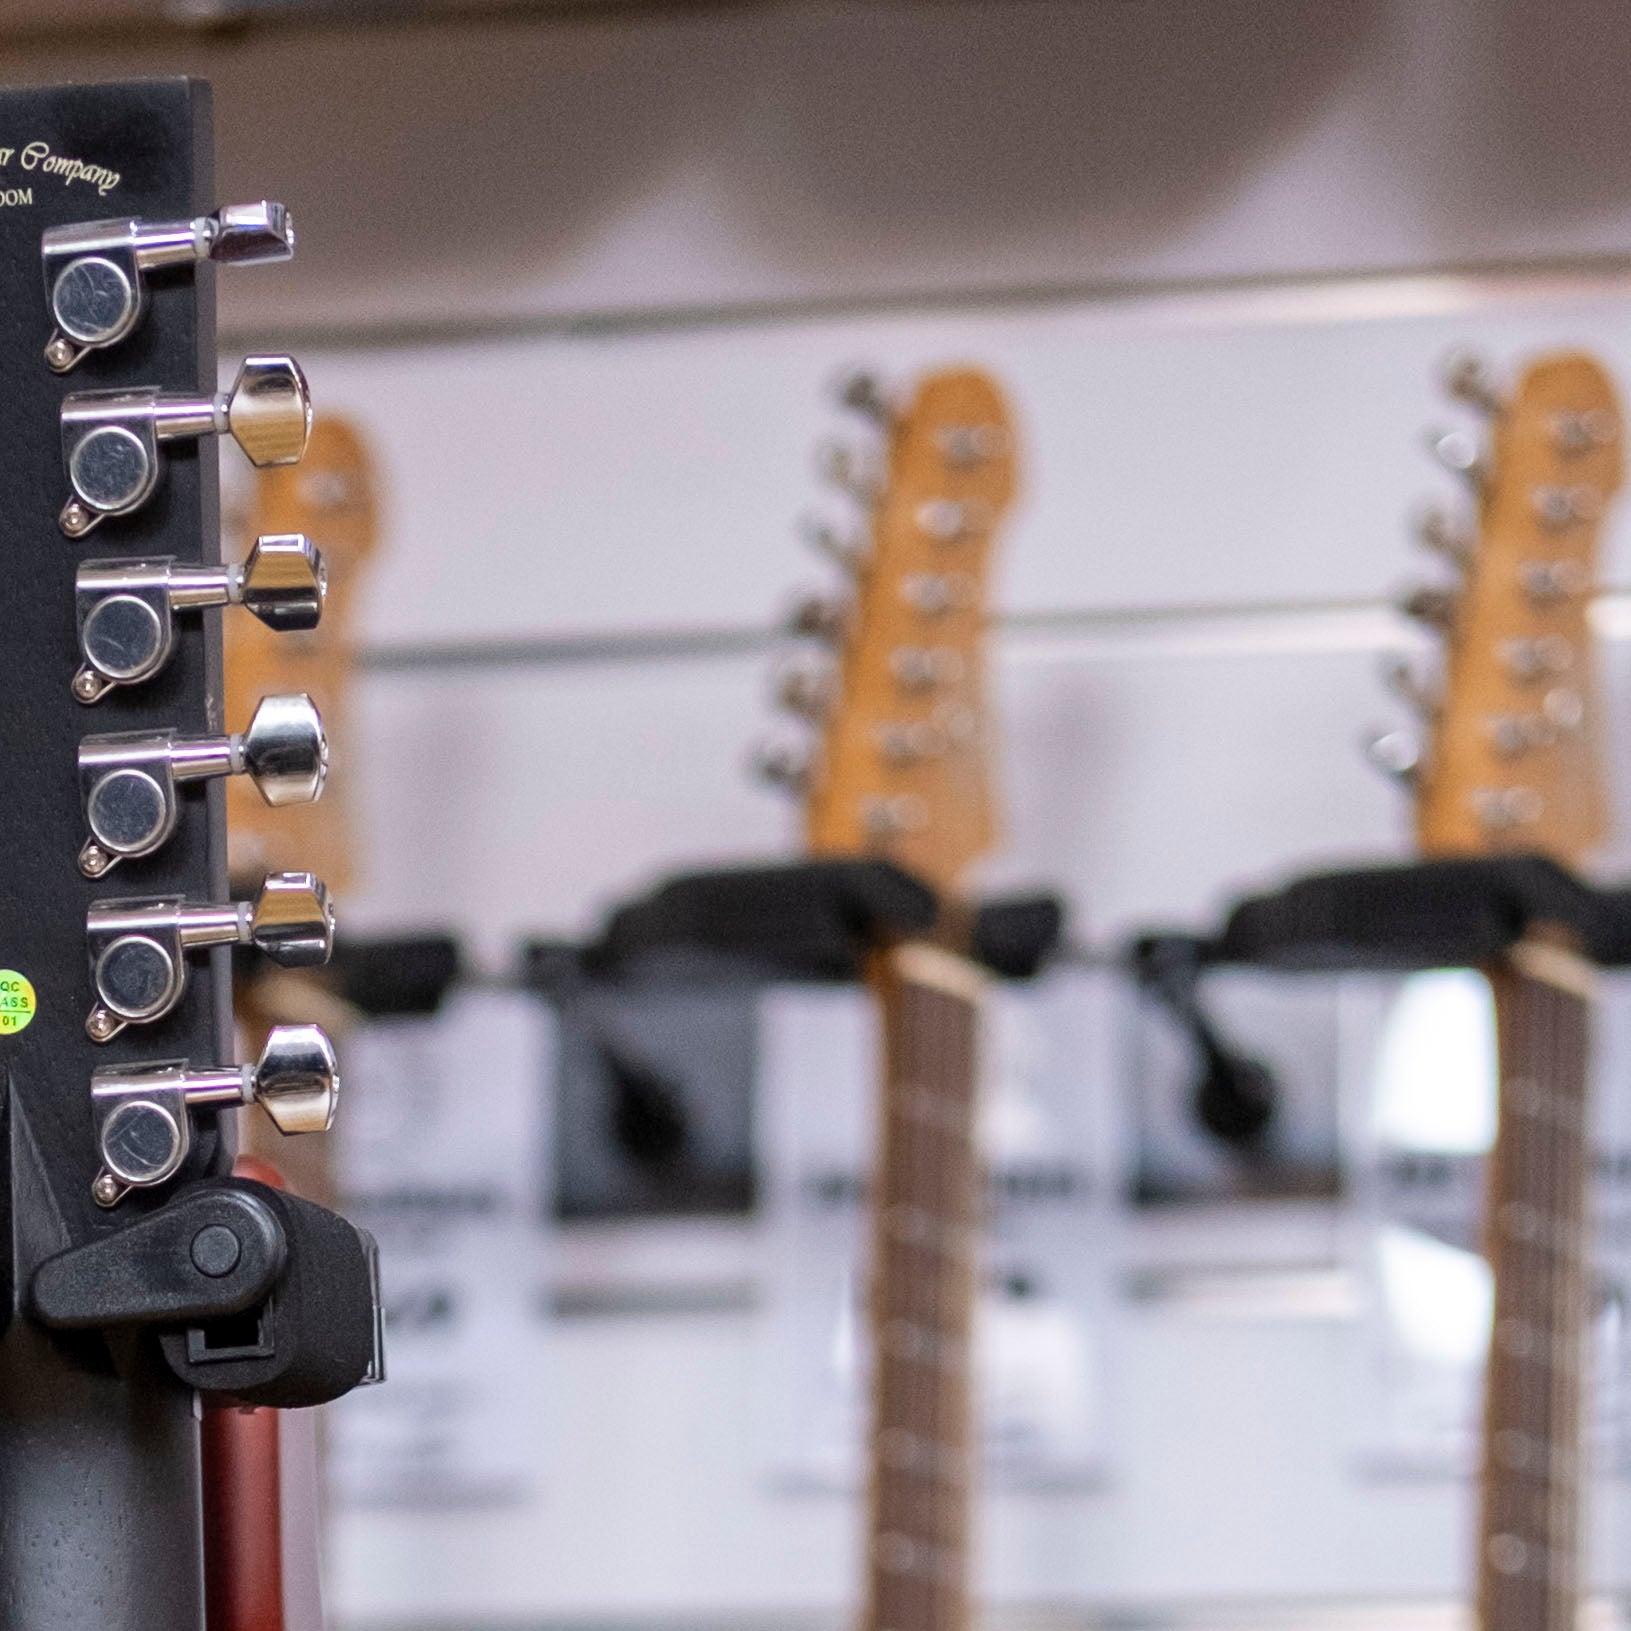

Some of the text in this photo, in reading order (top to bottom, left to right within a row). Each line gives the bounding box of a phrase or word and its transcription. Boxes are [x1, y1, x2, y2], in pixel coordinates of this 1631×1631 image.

[20, 141, 121, 196] Company
[0, 981, 20, 992] QC
[2, 1016, 17, 1026] 01
